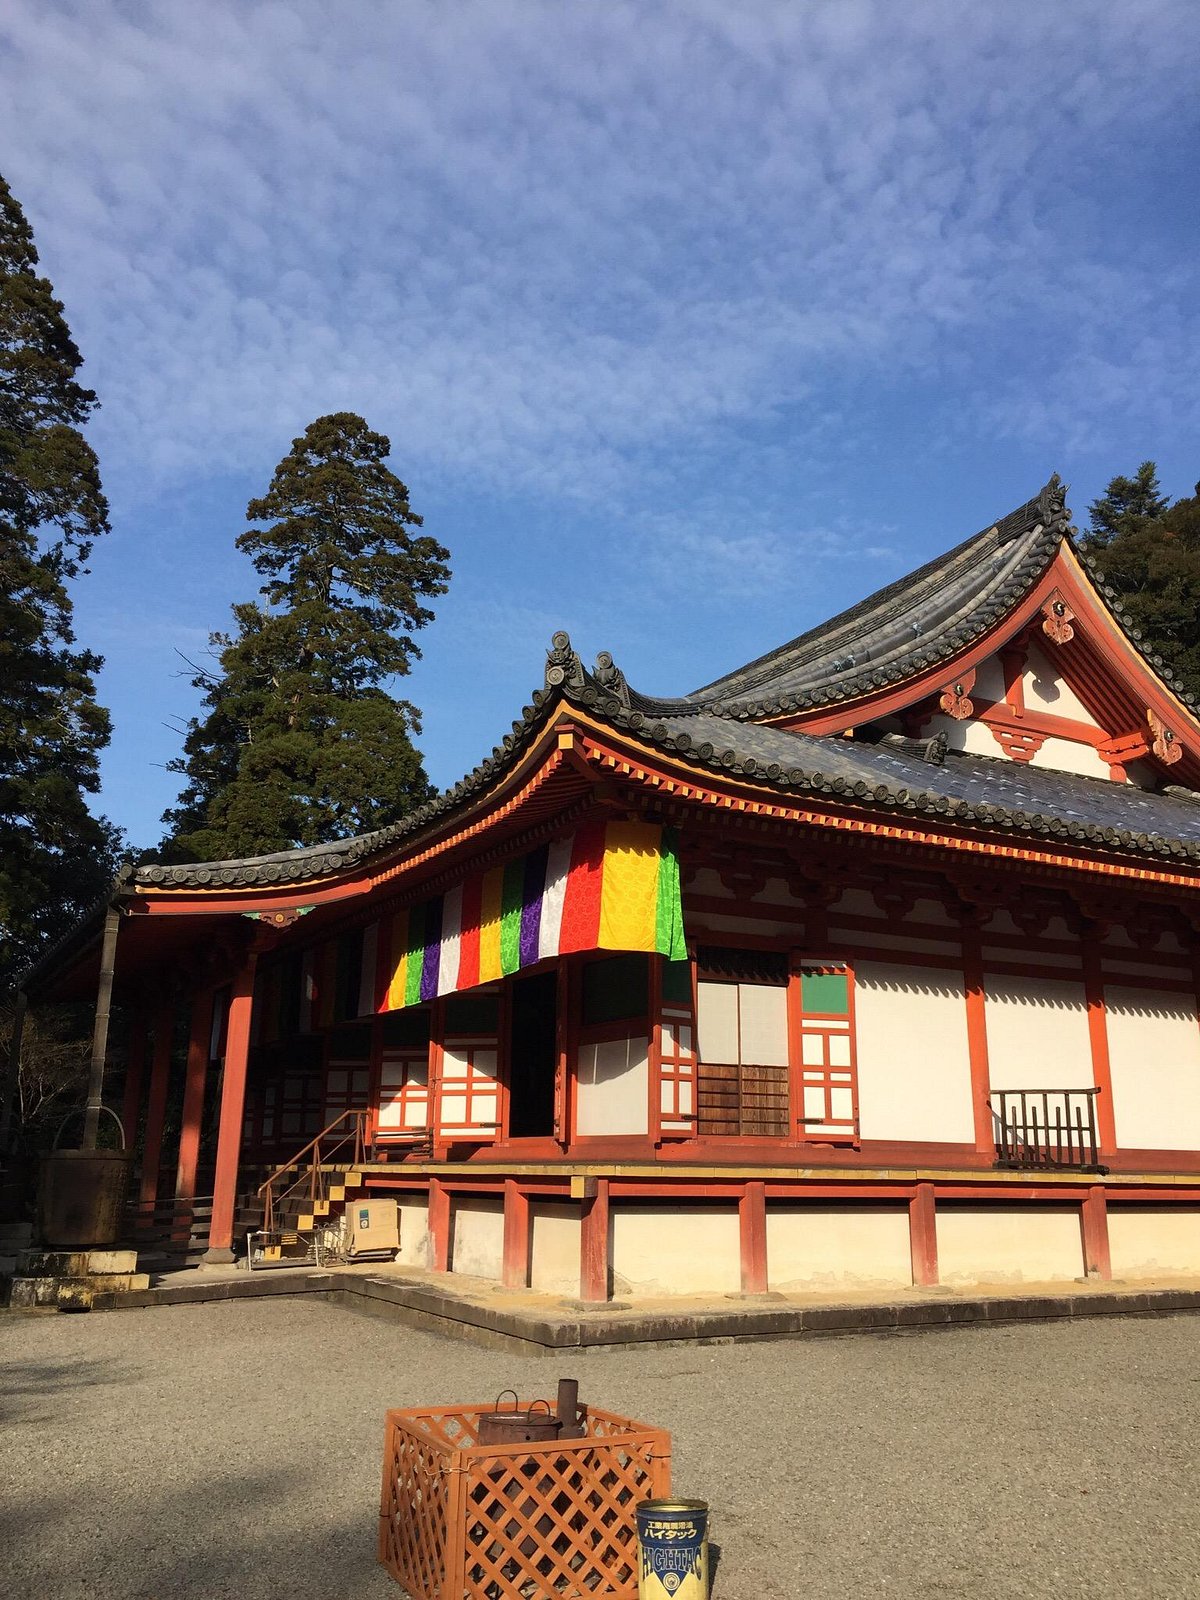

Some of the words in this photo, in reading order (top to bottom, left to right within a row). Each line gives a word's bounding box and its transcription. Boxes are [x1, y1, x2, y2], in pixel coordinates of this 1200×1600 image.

[644, 1528, 697, 1539] ハイタック
